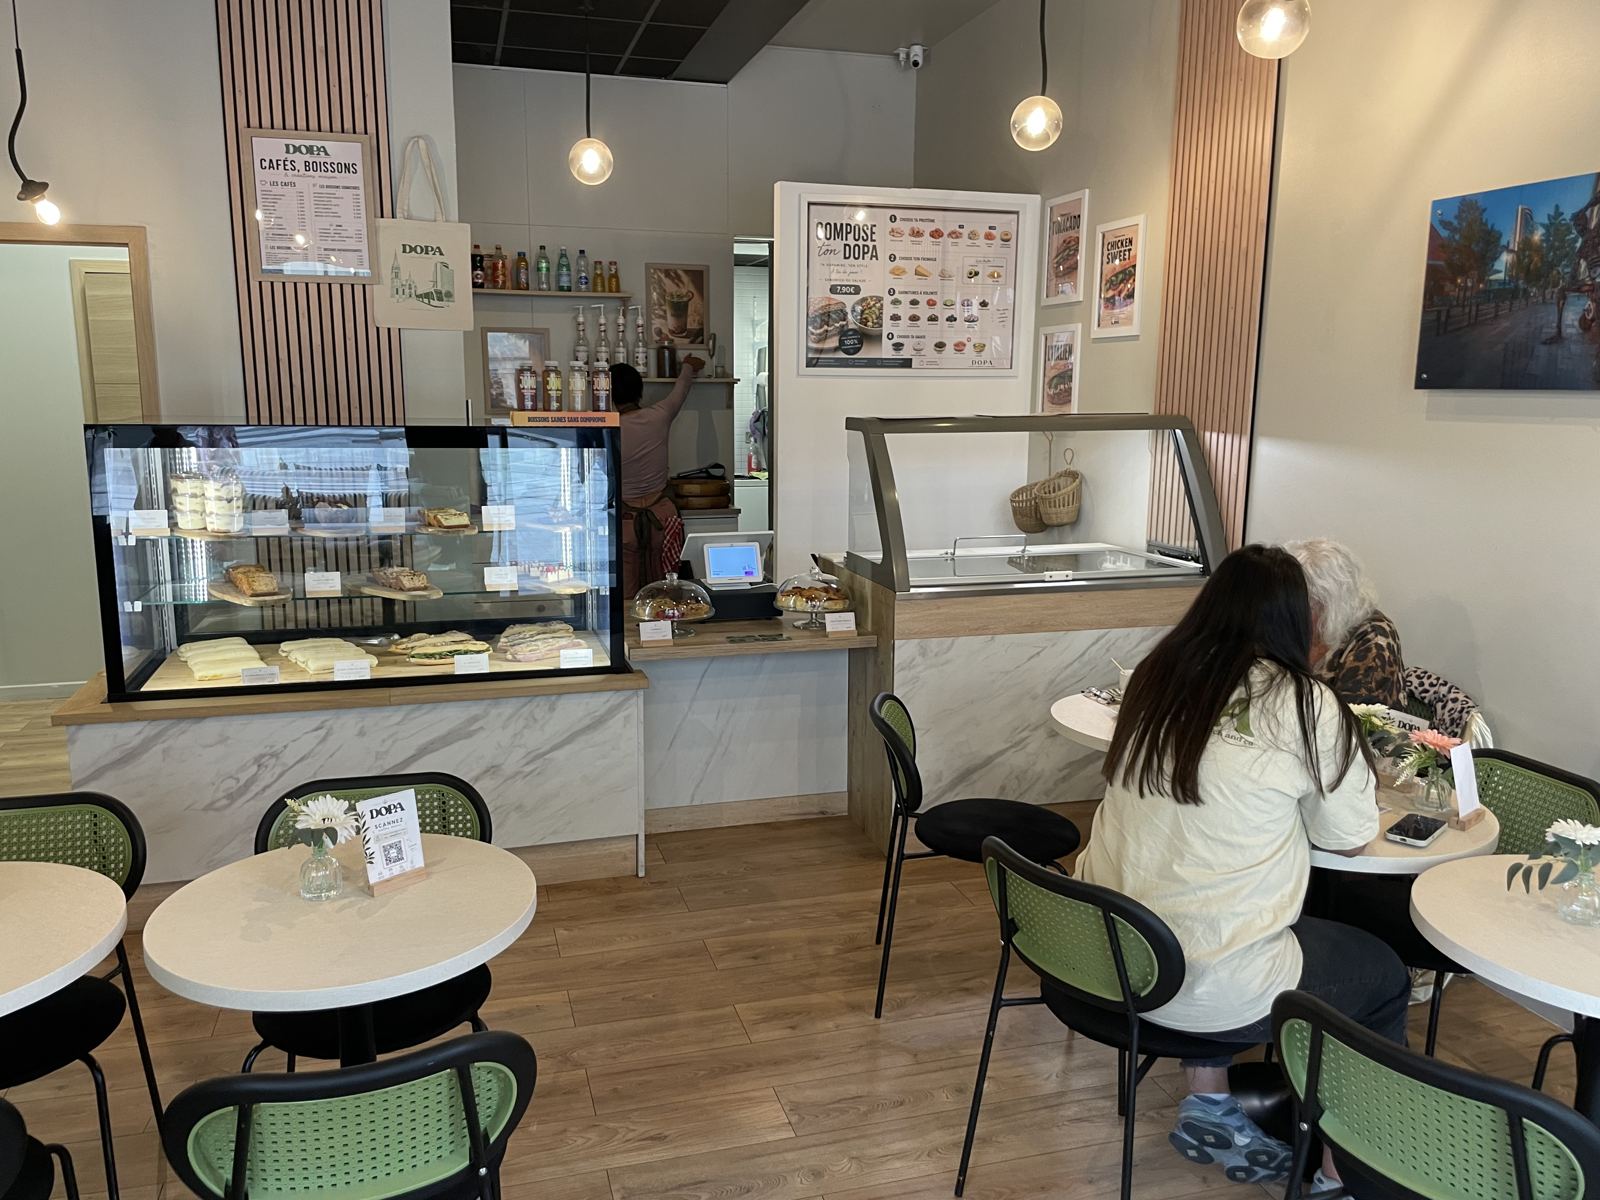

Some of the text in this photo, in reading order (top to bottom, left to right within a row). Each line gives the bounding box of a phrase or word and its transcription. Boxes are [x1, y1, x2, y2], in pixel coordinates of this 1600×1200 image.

[284, 143, 330, 156] DOPA
[260, 157, 358, 174] CAFÉS, BOISSONS
[816, 222, 877, 242] COMPOSE
[401, 244, 445, 256] DOPA
[817, 241, 841, 257] ton
[843, 243, 879, 260] DOPA
[1106, 236, 1133, 252] CHICKEN
[1106, 248, 1132, 264] SWEET
[369, 802, 406, 819] DOPA
[374, 817, 403, 830] SCANNEZ
